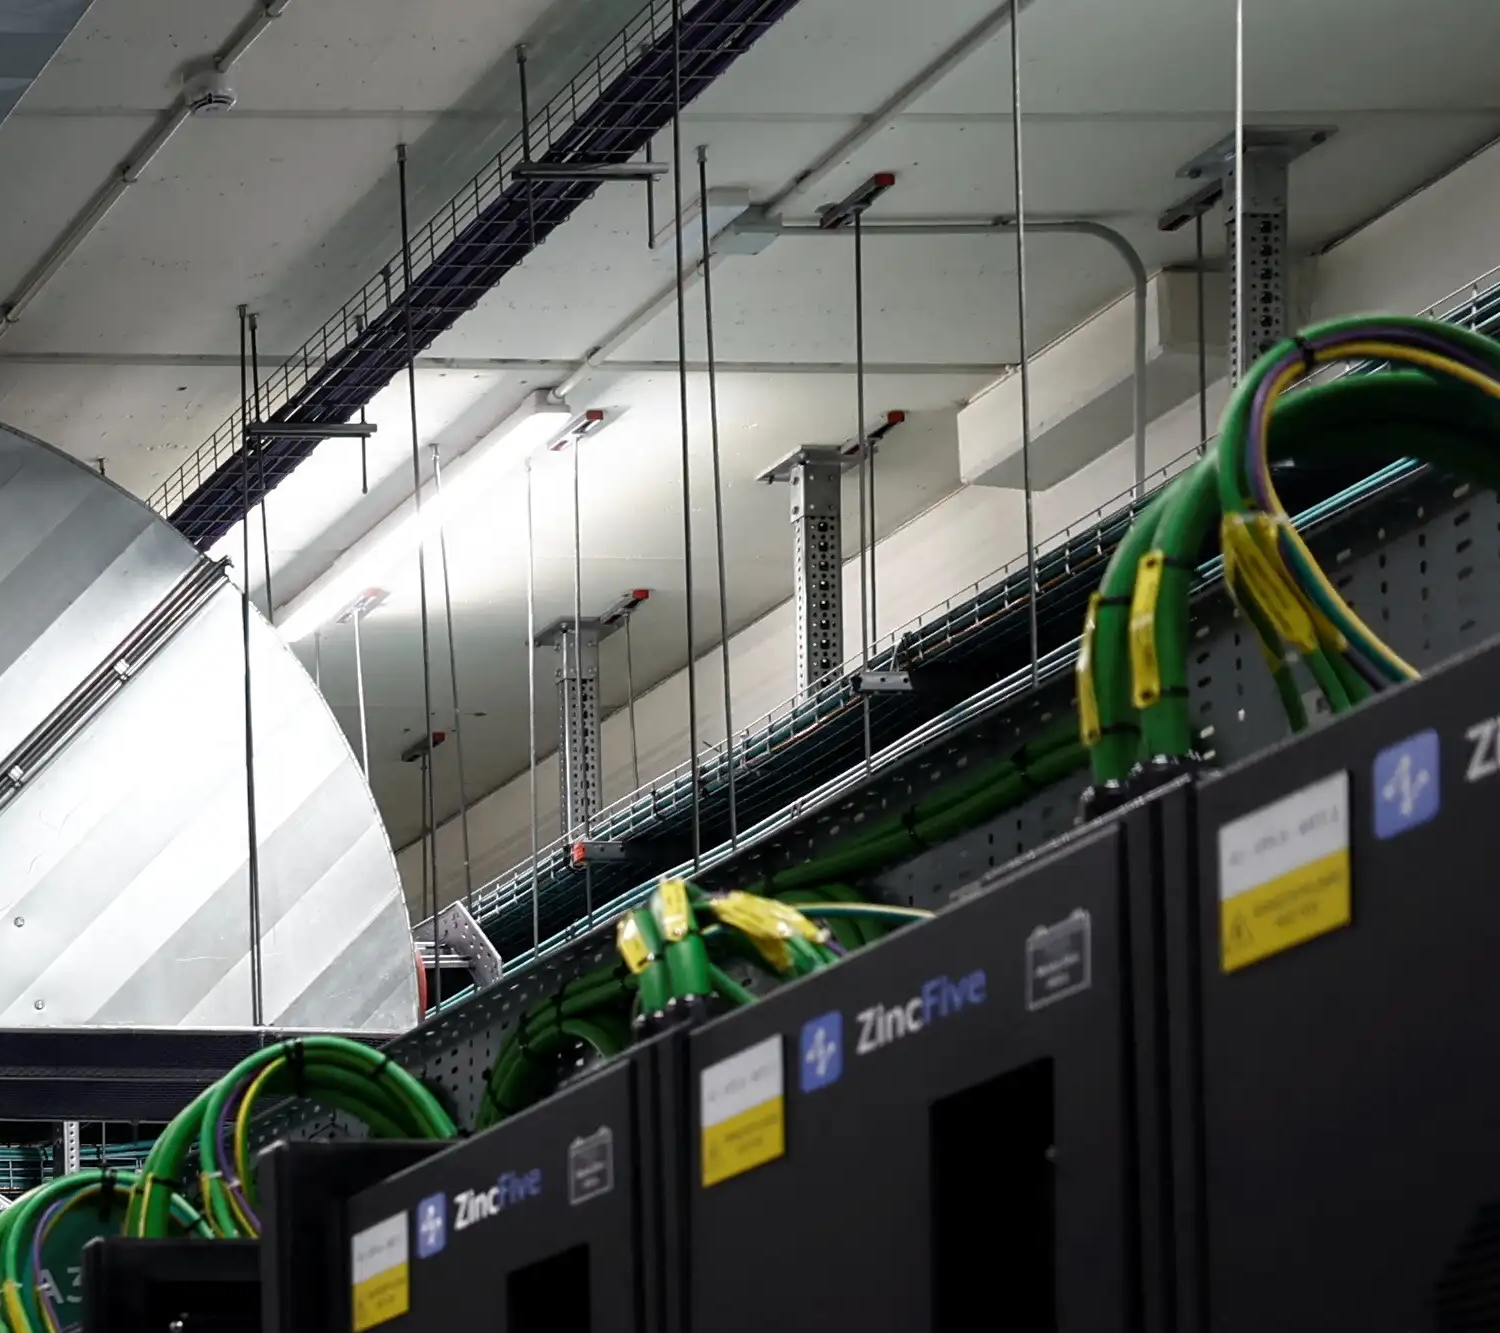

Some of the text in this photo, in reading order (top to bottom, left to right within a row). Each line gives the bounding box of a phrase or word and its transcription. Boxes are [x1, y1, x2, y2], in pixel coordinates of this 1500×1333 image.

[1465, 715, 1500, 782] Z
[857, 967, 986, 1055] ZincFive
[454, 1169, 541, 1230] ZincFive
